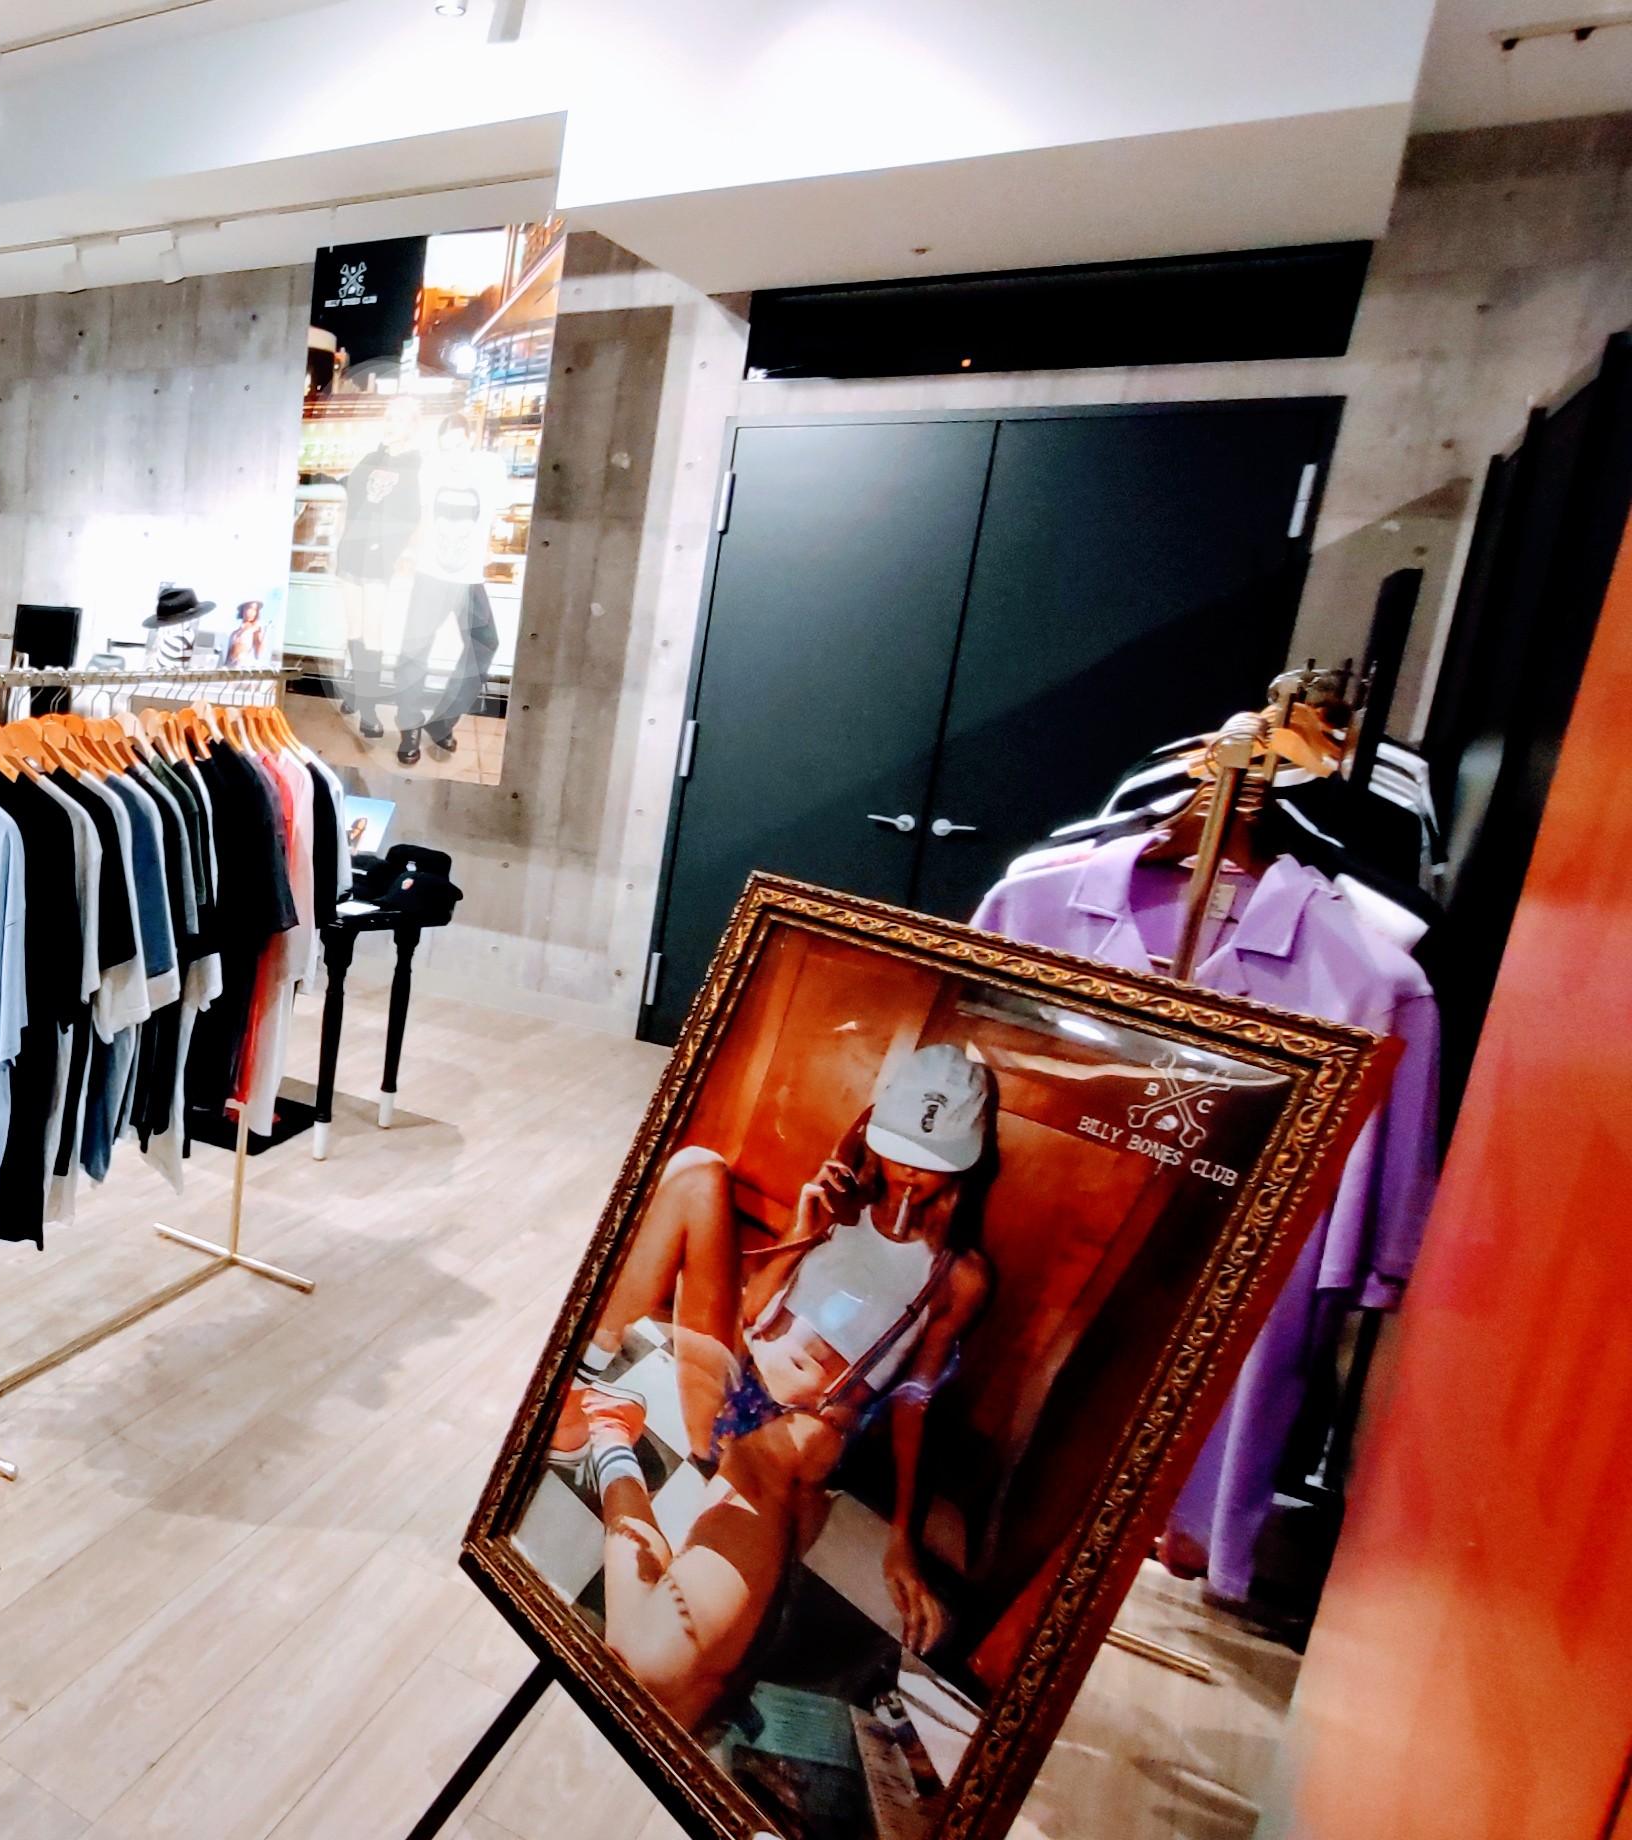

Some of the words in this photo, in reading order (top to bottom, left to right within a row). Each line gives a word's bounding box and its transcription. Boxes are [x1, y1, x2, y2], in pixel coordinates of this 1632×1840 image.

[1144, 1082, 1160, 1096] B
[1196, 1099, 1215, 1114] C
[1076, 1116, 1124, 1143] BILLY
[1126, 1134, 1184, 1165] BONES
[1190, 1159, 1239, 1187] CLUB
